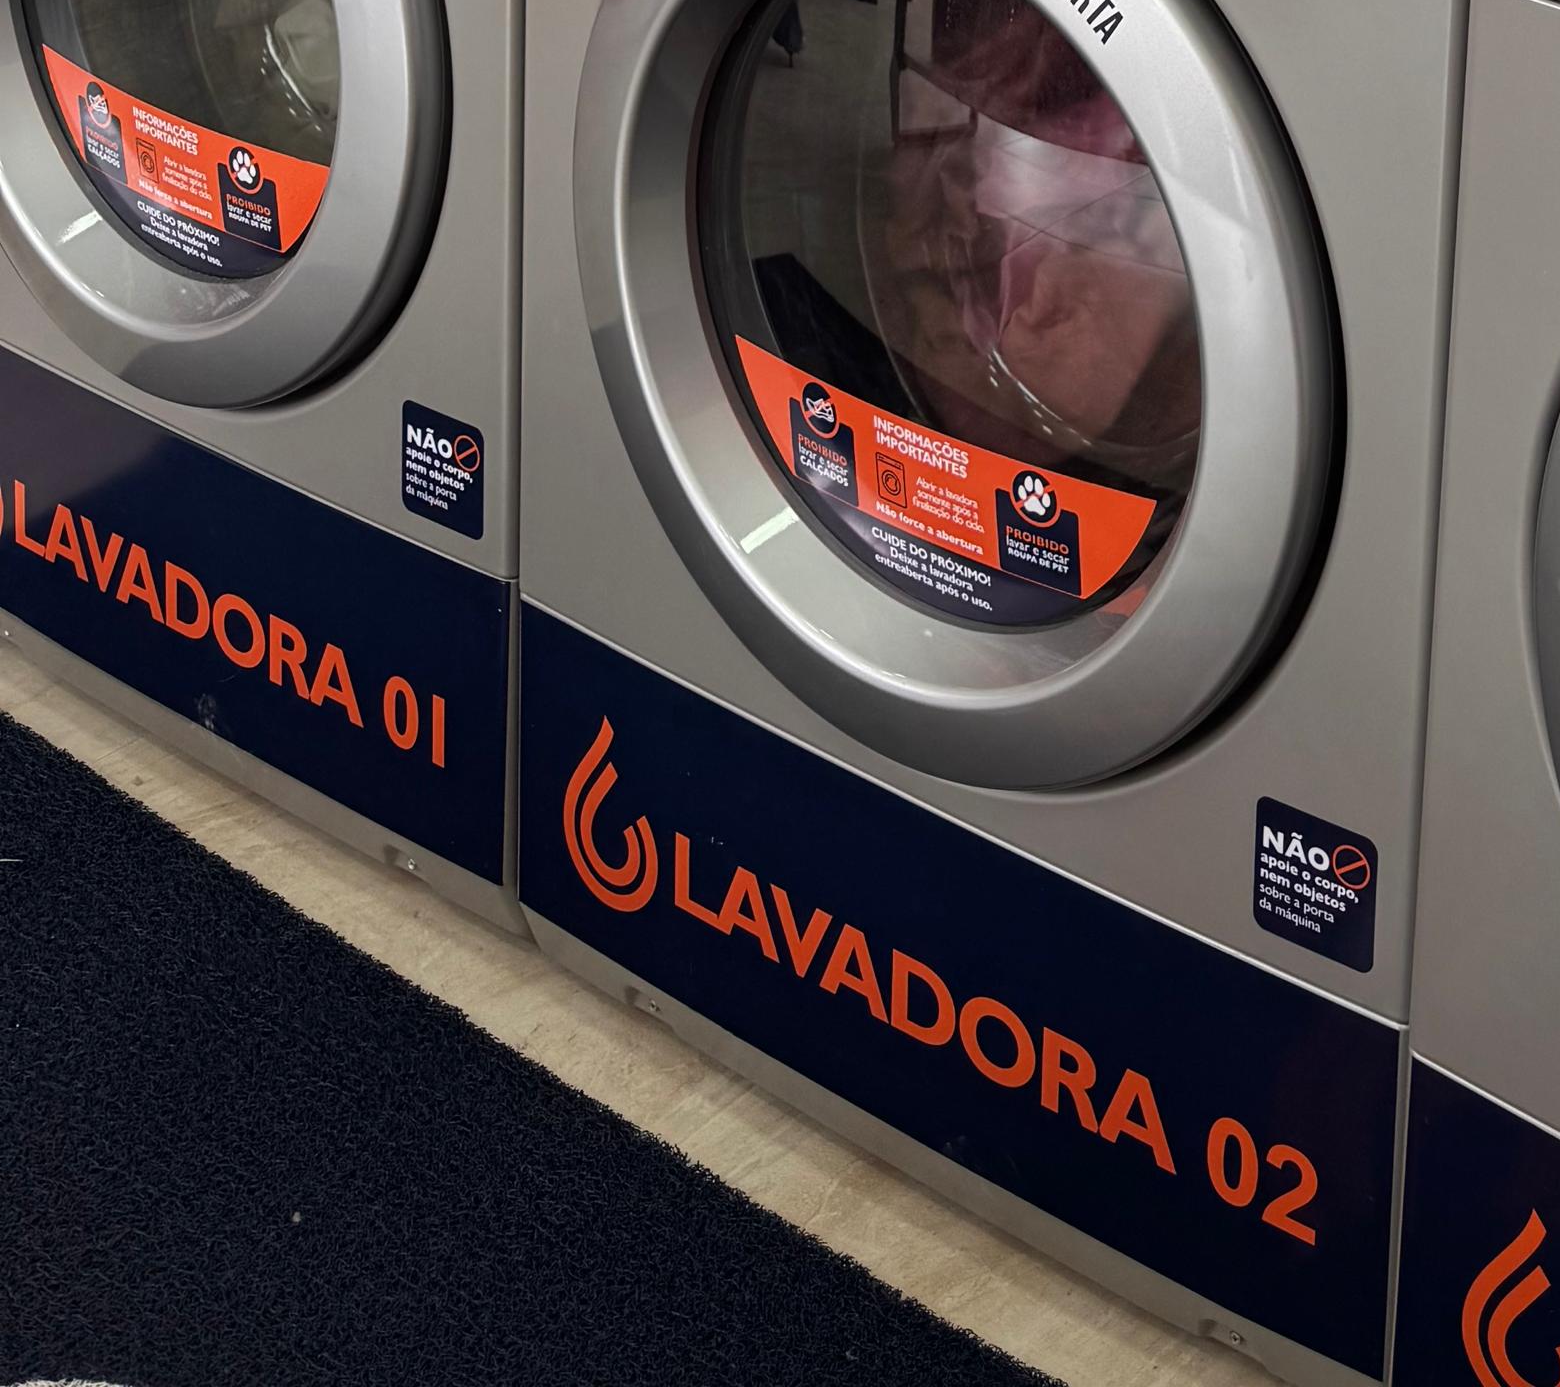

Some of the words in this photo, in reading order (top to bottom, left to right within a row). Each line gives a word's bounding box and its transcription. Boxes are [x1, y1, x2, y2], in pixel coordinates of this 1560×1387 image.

[135, 120, 198, 156] IMPORTANTES
[407, 424, 453, 459] NÃO
[873, 415, 969, 465] INFORMAÇÕES
[876, 431, 968, 479] IMPORTANTES
[14, 480, 364, 729] LAVADORA
[382, 675, 446, 769] 01
[1262, 825, 1330, 872] NÃO
[1260, 852, 1299, 877] apoie
[1302, 872, 1311, 881] o
[1314, 876, 1359, 904] corpo,
[1260, 867, 1290, 889] nem
[1294, 881, 1346, 912] objetos
[1259, 883, 1291, 904] sobre
[1294, 898, 1300, 908] a
[1303, 902, 1334, 924] porta
[1259, 897, 1272, 912] da
[1275, 904, 1321, 933] máquina
[673, 831, 1177, 1176] LAVADORA
[1206, 1117, 1319, 1247] 02
